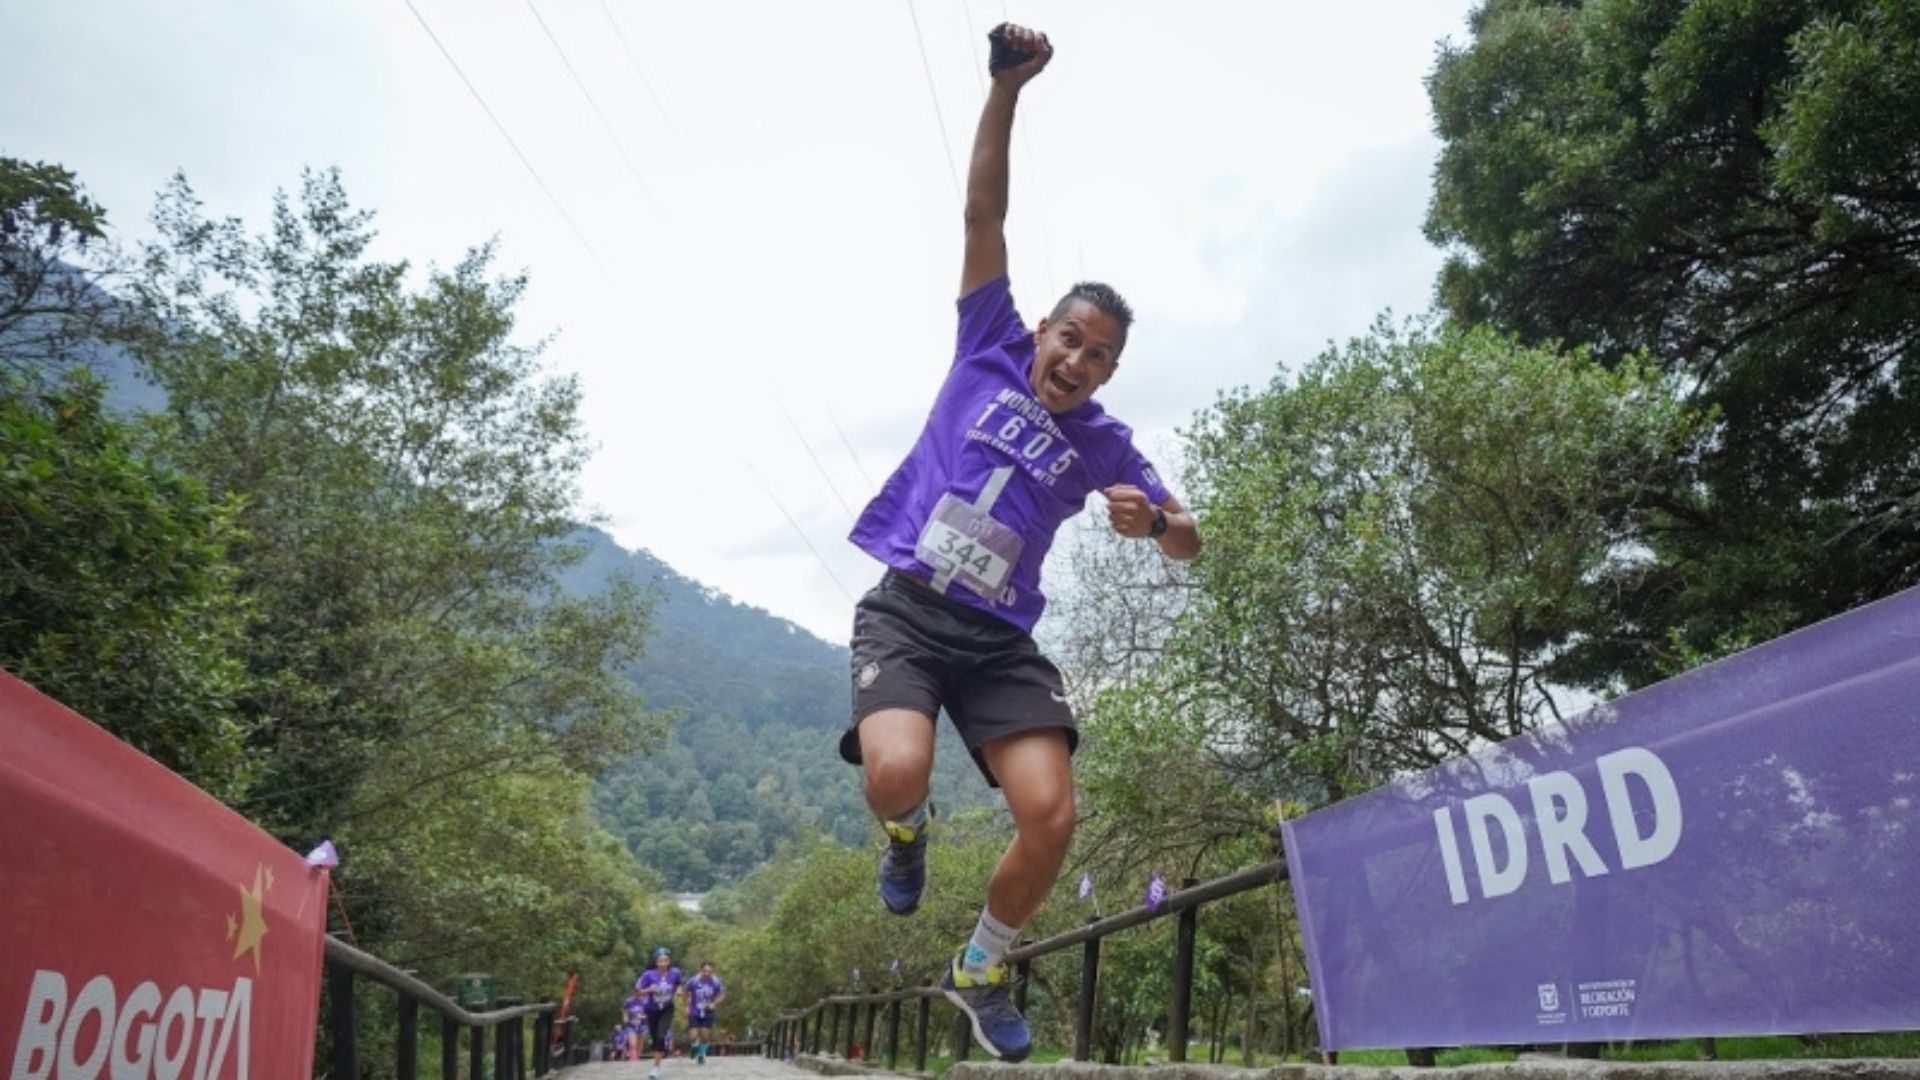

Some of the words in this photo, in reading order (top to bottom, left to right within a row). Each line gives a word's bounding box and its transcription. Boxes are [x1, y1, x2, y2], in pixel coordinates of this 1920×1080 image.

[976, 403, 1080, 475] 1605
[937, 529, 993, 577] 344
[1434, 746, 1683, 905] IDRD
